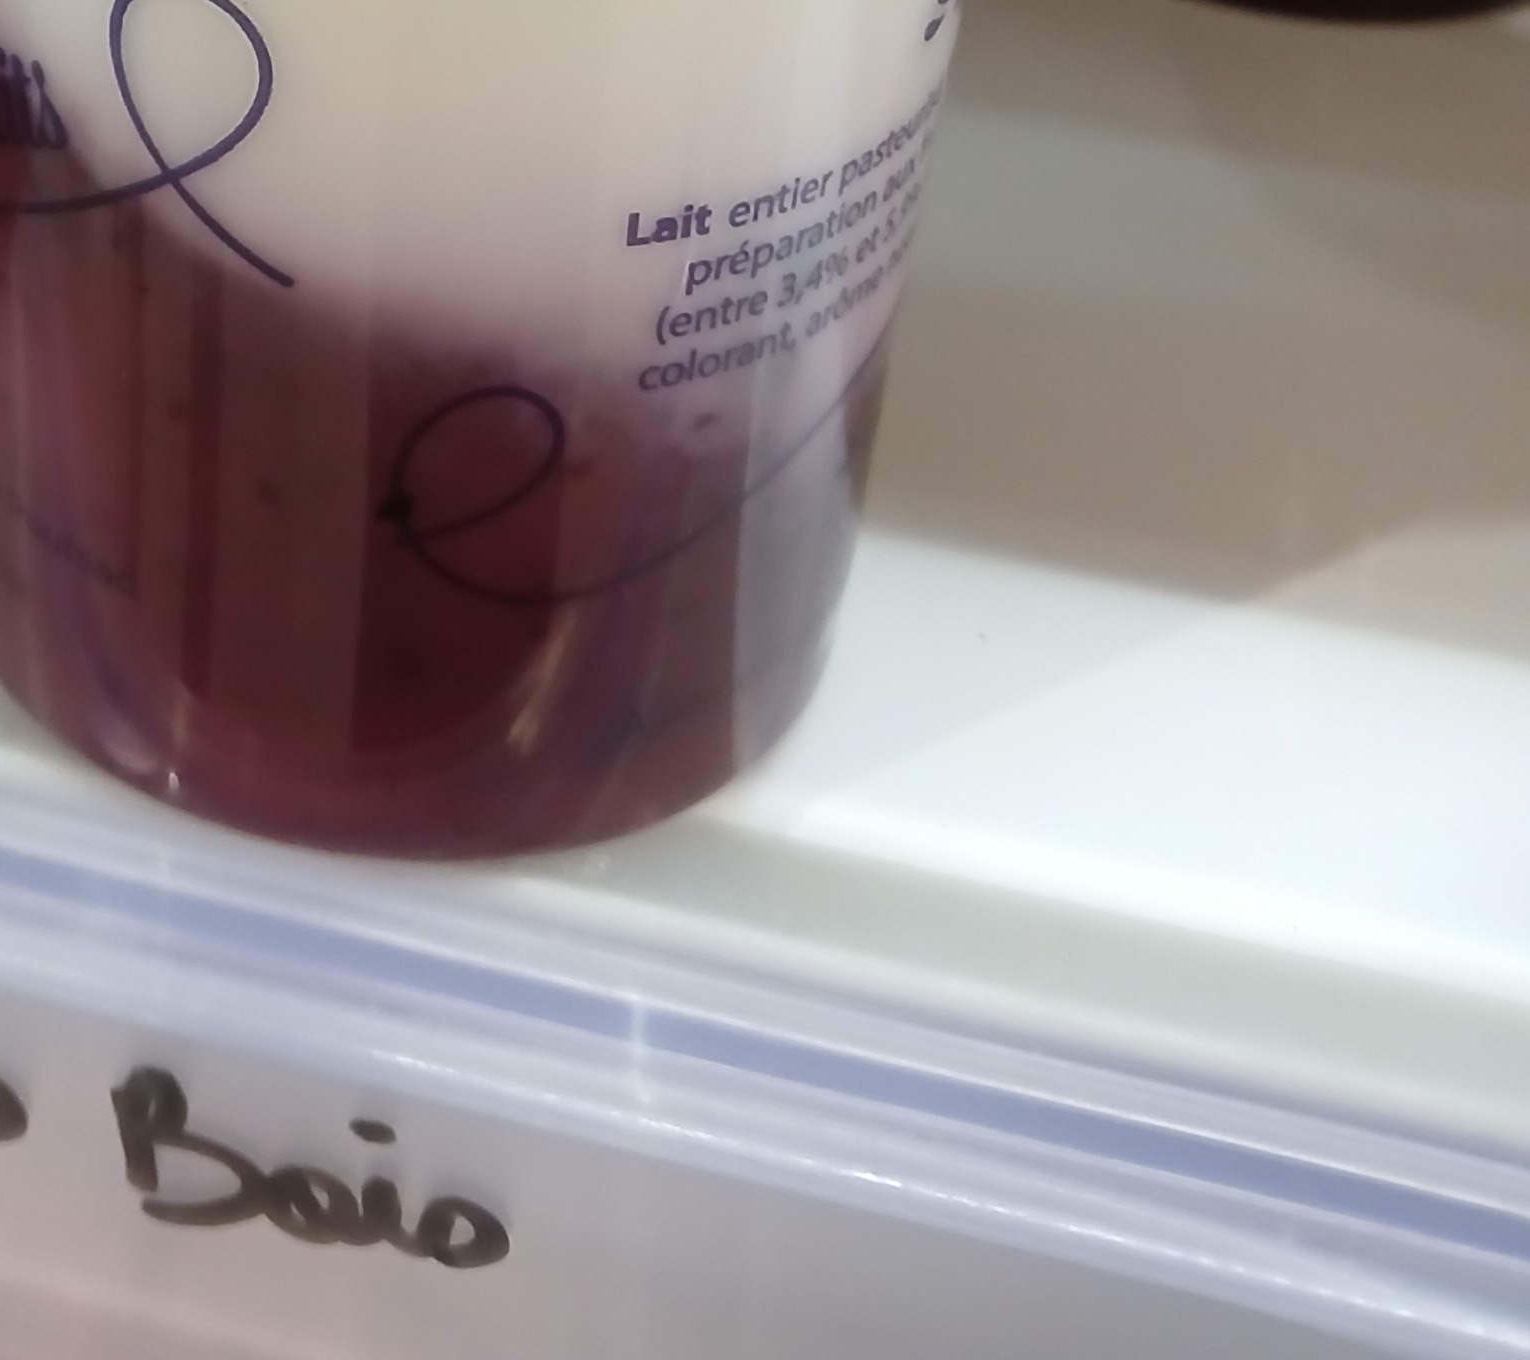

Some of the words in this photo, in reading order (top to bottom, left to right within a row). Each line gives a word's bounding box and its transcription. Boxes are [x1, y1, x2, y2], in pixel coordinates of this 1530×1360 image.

[625, 203, 712, 247] Lait
[727, 167, 834, 229] entier
[838, 83, 943, 197] pasteuris
[654, 286, 769, 347] (entre
[775, 250, 850, 312] 3,4%
[854, 228, 881, 267] et
[684, 185, 878, 296] préparation
[637, 321, 797, 392] colorant,
